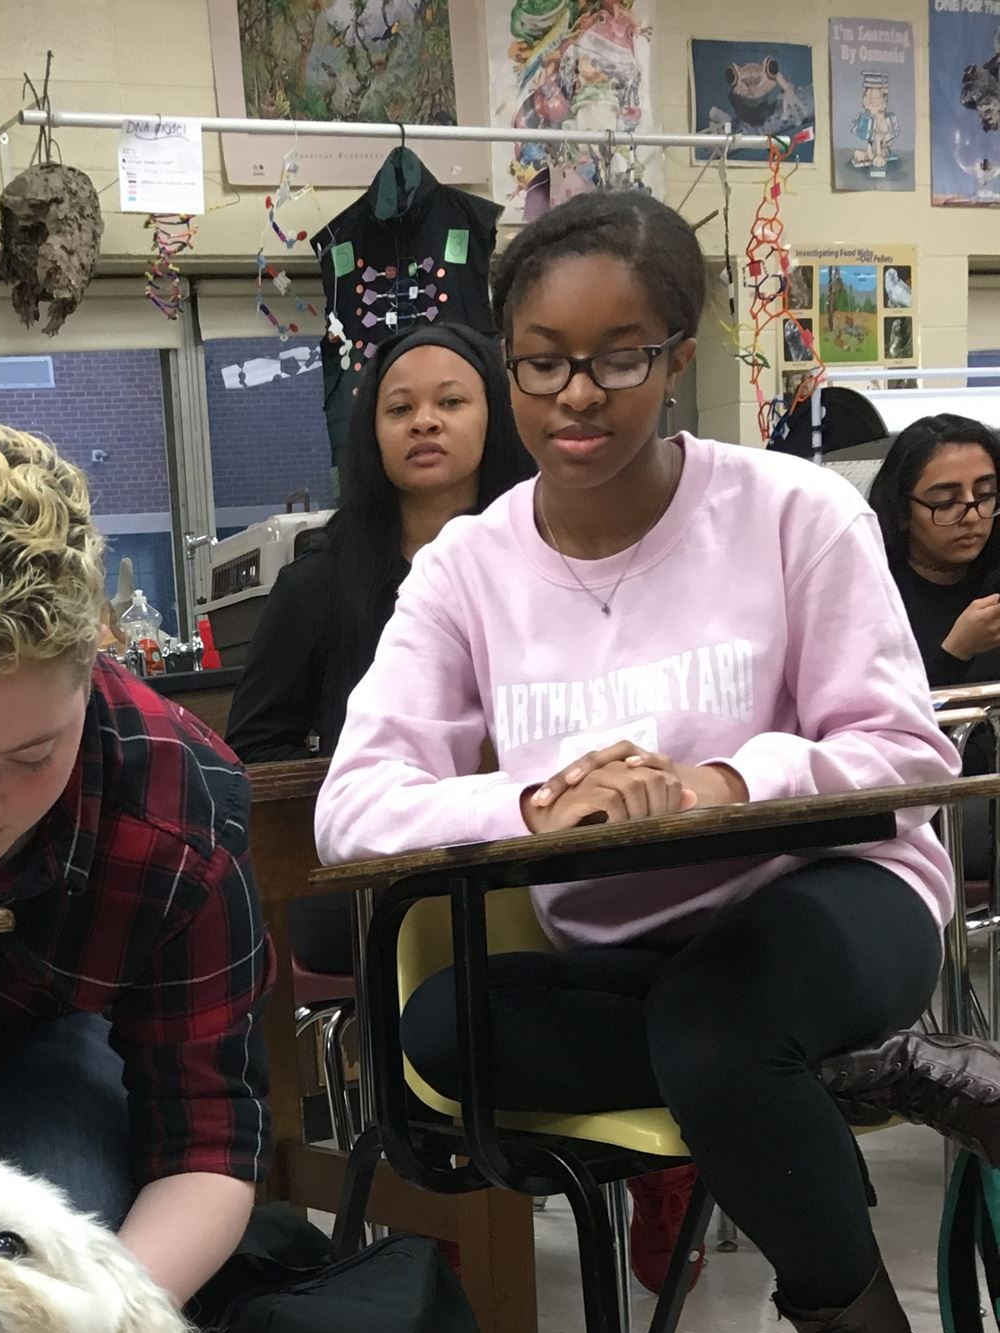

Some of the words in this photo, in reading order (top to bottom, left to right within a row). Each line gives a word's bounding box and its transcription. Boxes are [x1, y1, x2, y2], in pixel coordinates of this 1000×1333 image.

[833, 25, 854, 41] I'm
[859, 25, 909, 47] Learning
[840, 45, 857, 64] By
[860, 46, 905, 63] Osmosis
[126, 120, 150, 134] DNA
[796, 248, 839, 258] Investigating
[840, 249, 856, 257] Food
[873, 255, 893, 263] Pellets
